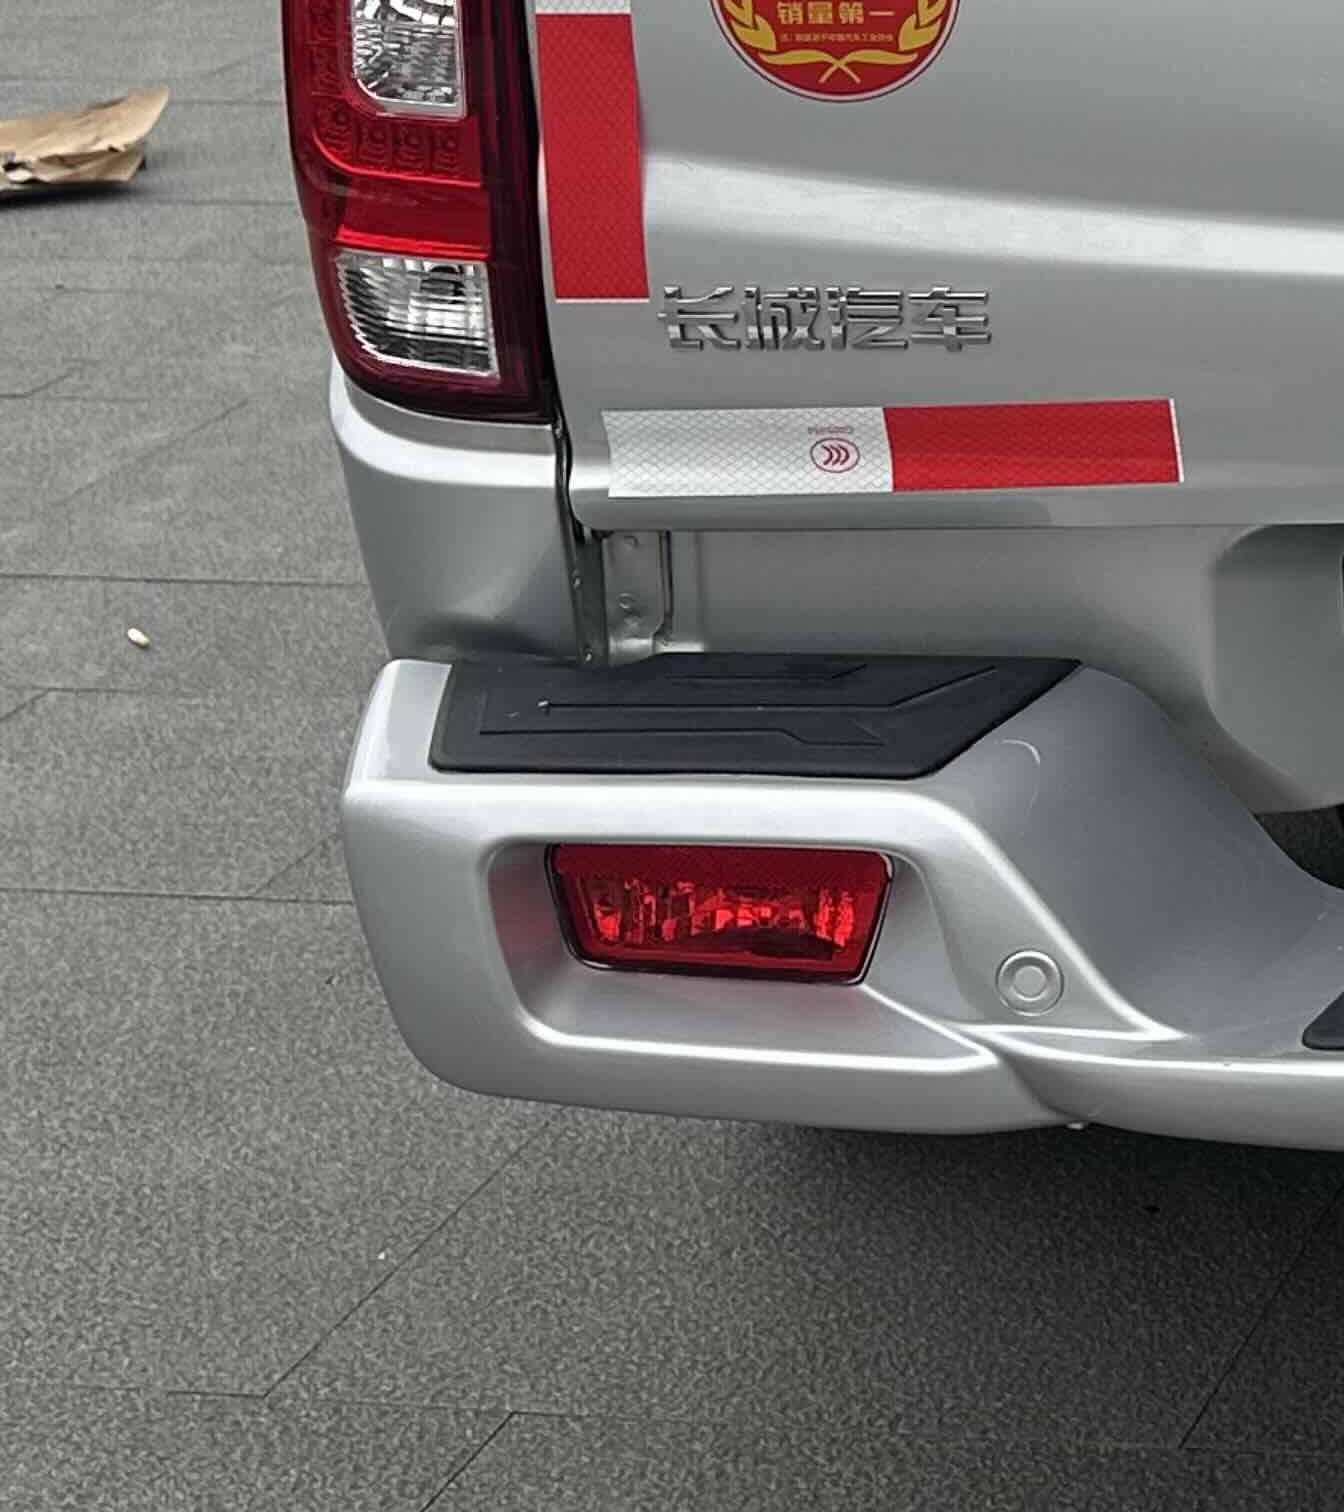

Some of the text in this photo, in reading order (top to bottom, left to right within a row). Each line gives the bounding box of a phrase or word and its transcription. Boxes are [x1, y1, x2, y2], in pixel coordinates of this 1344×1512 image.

[777, 1, 895, 25] 销量第一
[658, 286, 991, 350] 长城汽车
